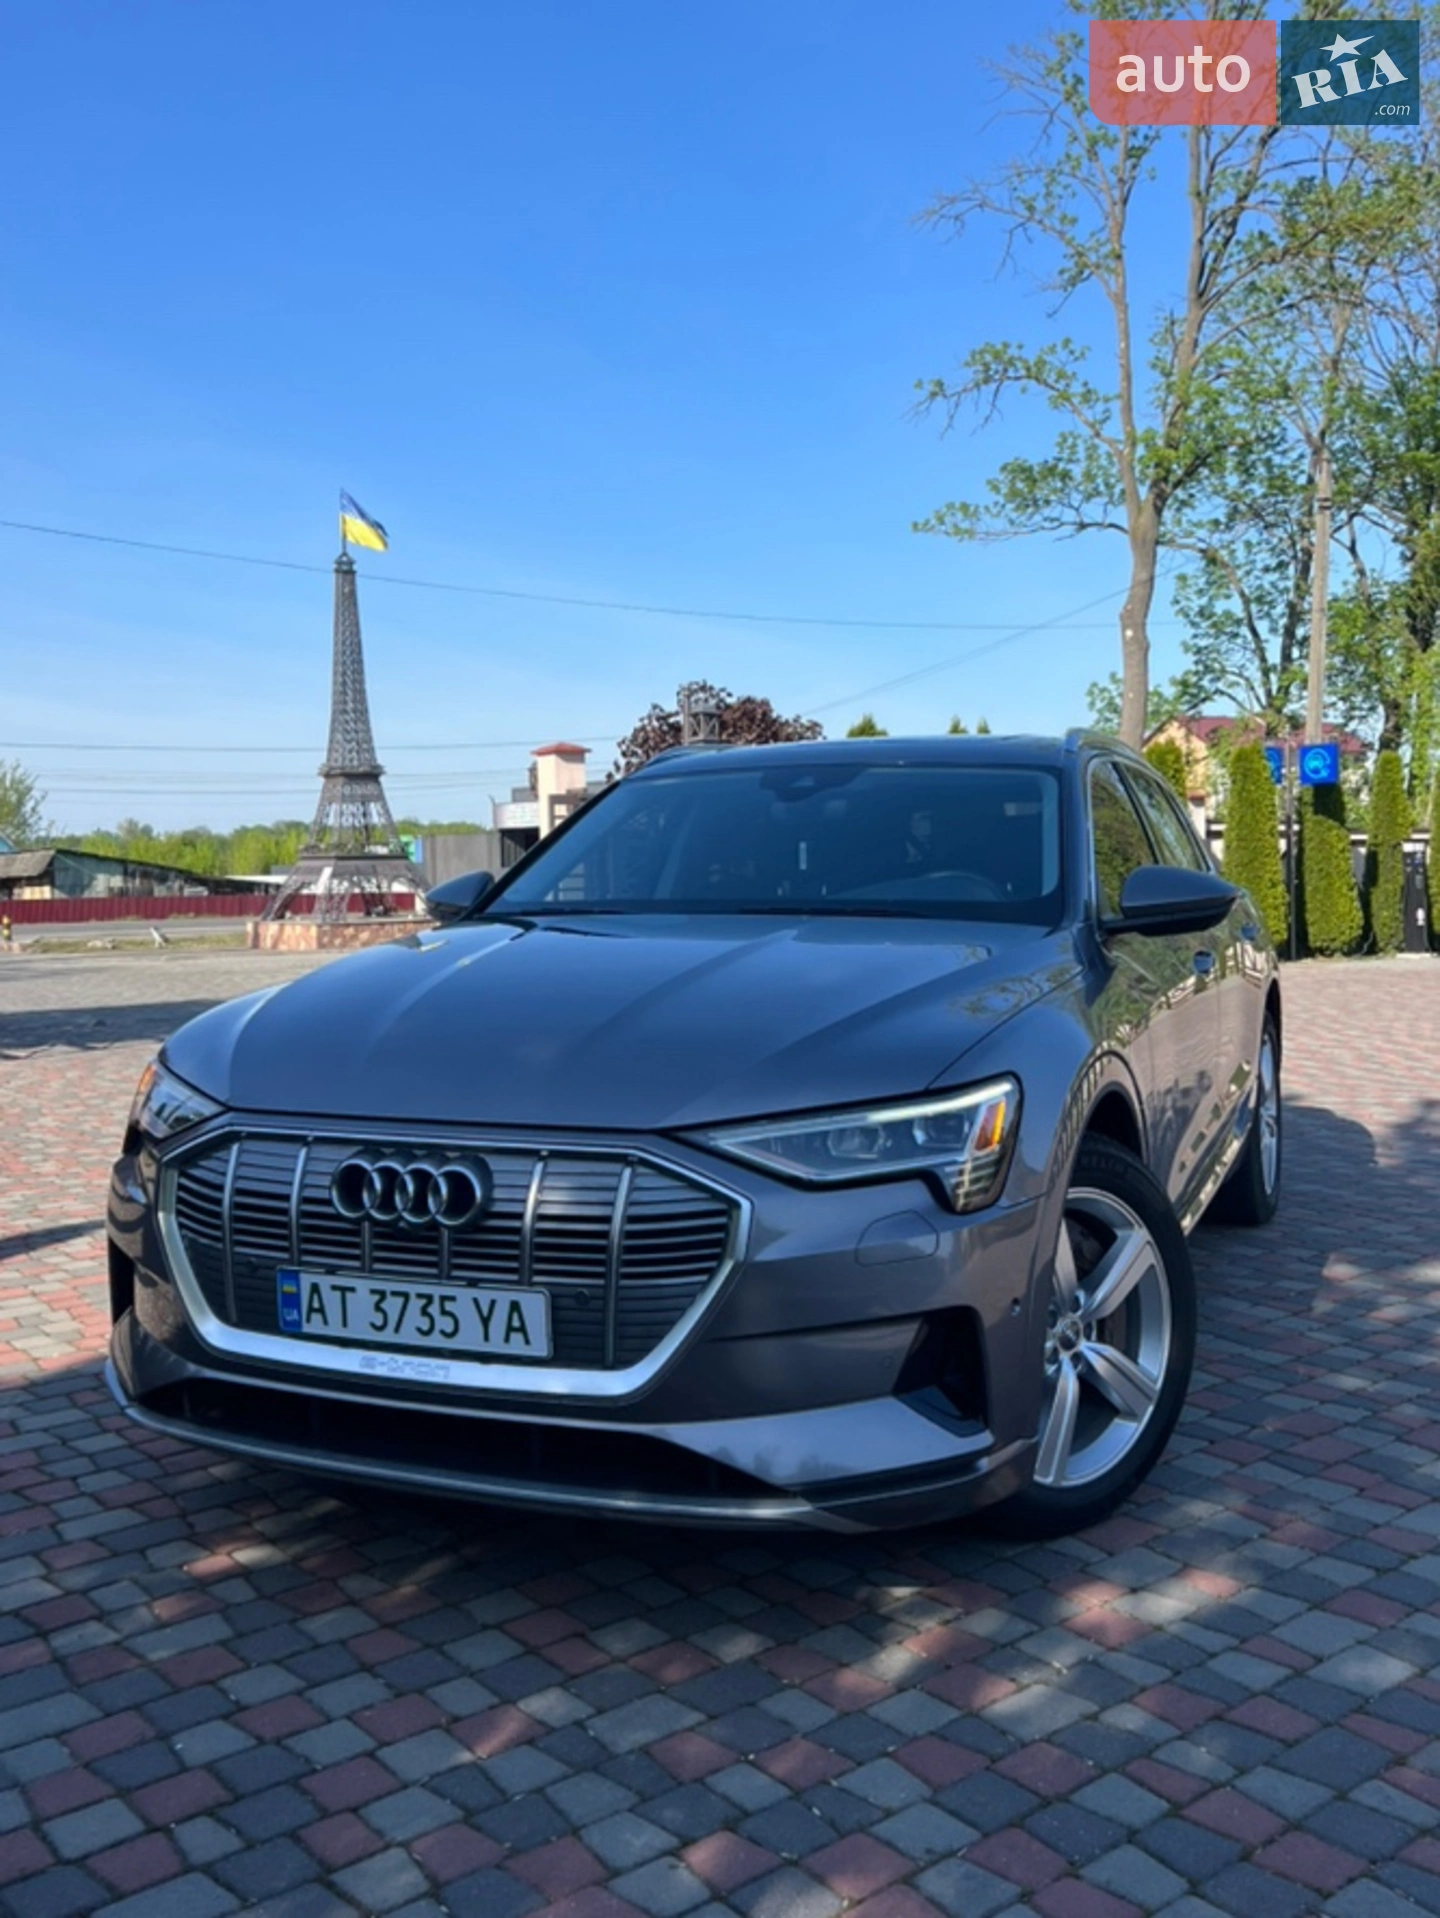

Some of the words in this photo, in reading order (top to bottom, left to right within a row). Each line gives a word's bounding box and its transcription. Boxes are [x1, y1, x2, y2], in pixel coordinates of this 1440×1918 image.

[305, 1282, 357, 1329] AT
[368, 1289, 460, 1339] 3735
[472, 1297, 532, 1346] YA
